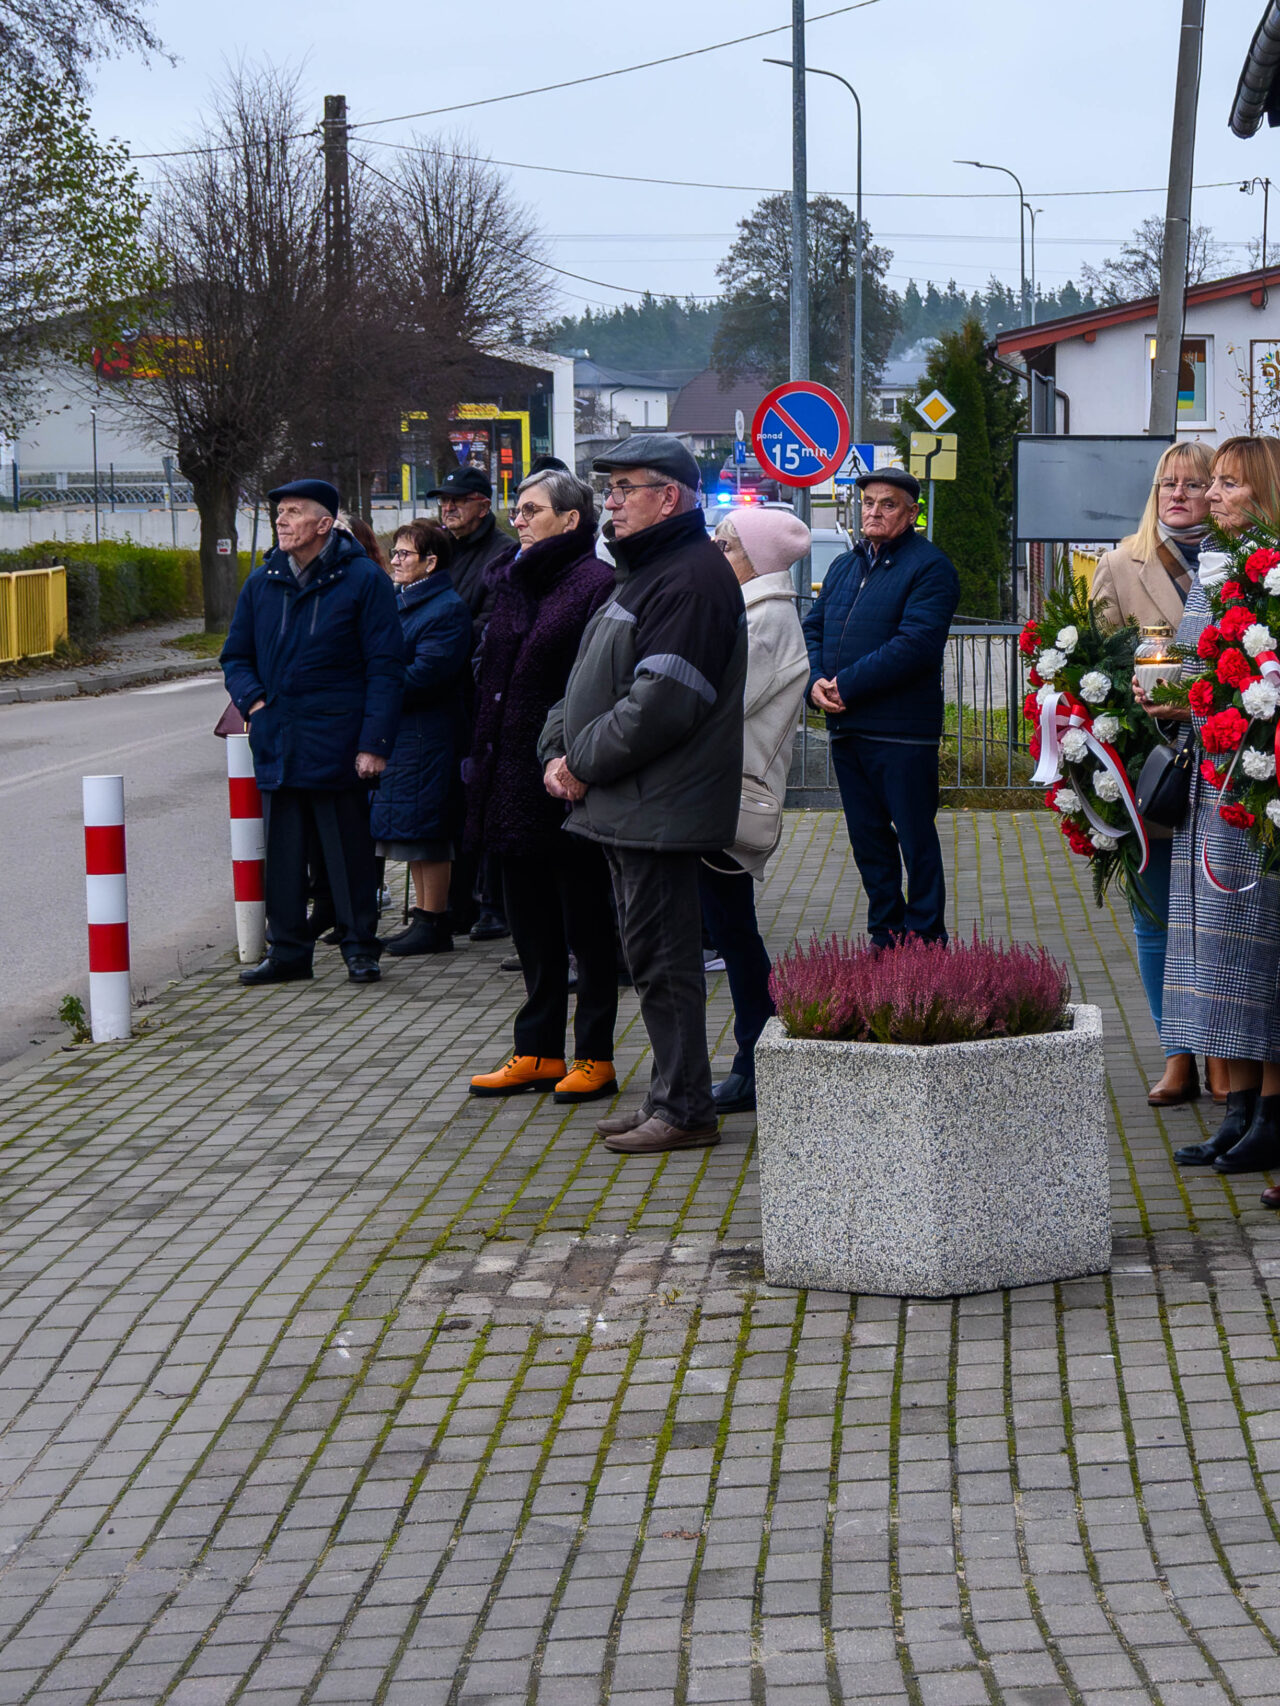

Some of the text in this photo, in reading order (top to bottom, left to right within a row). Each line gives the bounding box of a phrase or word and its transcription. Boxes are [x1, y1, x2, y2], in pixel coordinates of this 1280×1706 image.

[756, 432, 783, 441] ponad
[772, 443, 832, 470] 15 min.
